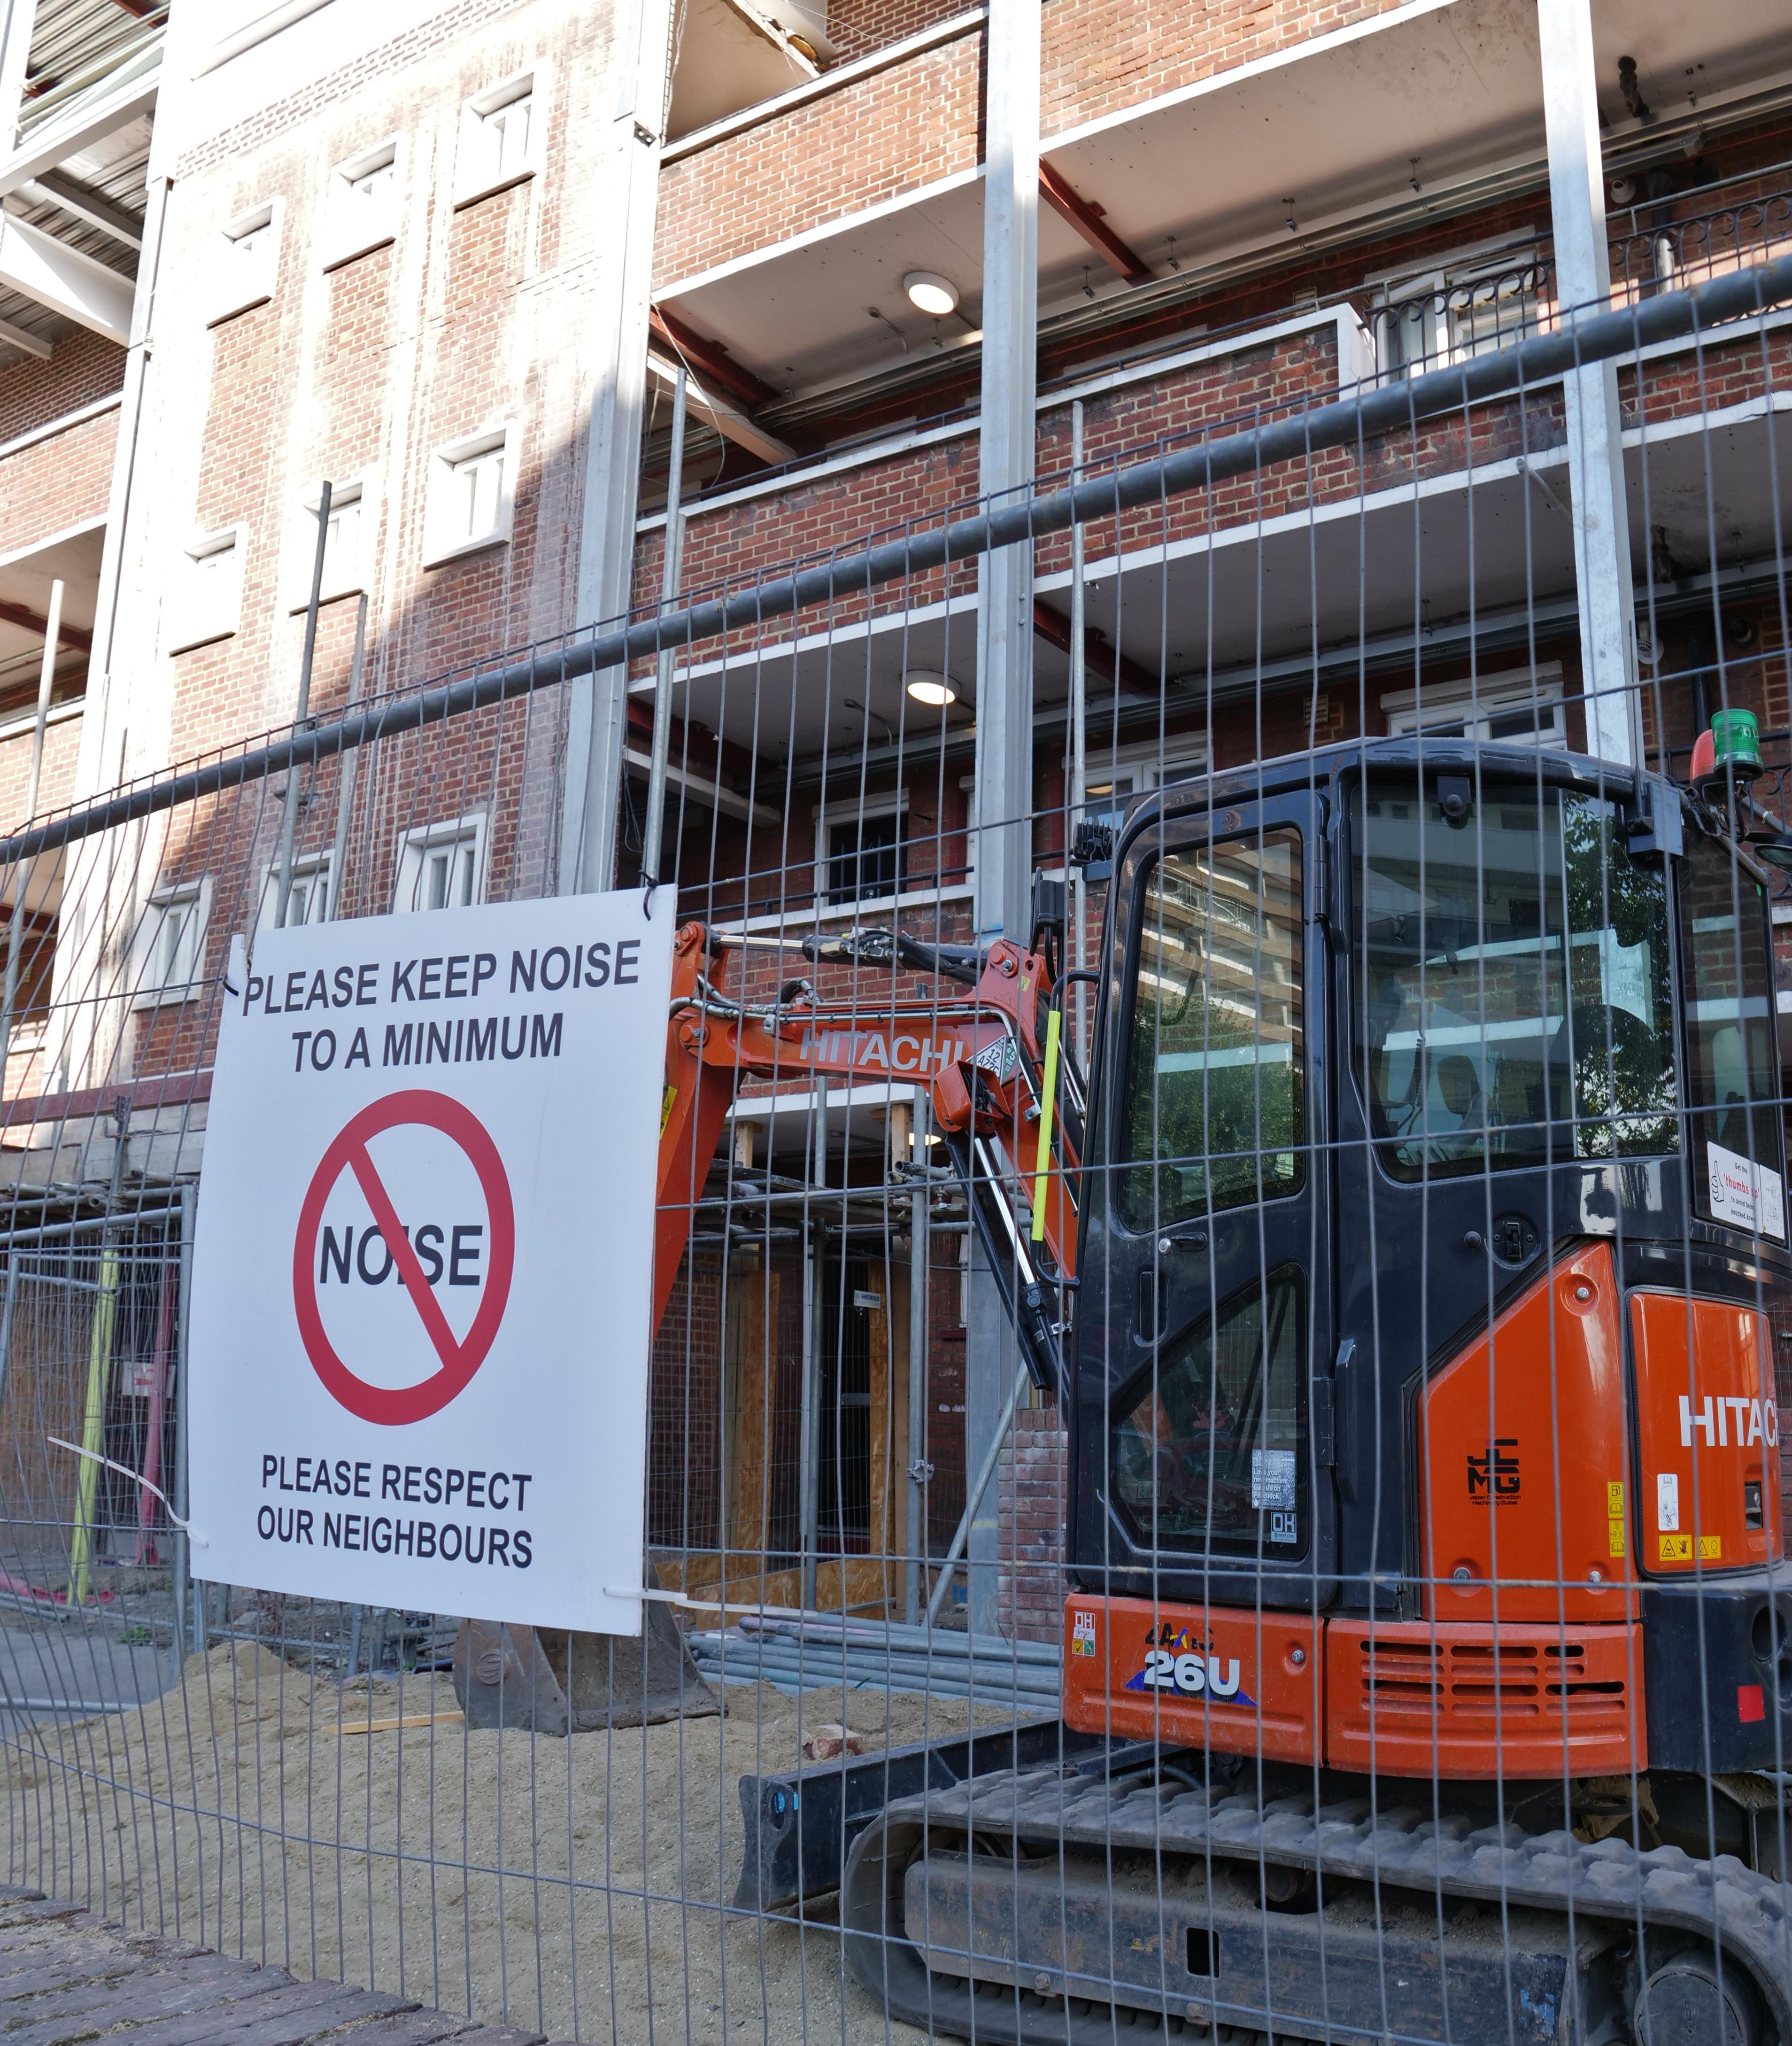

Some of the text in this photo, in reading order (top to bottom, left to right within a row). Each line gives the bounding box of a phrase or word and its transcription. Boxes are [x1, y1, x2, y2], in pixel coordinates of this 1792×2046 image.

[243, 940, 640, 1016] PLEASE KEEP NOISE
[292, 1013, 563, 1072] TO A MINIMUM
[800, 1027, 963, 1073] HITACHI
[988, 1049, 1000, 1063] 12
[1723, 1173, 1749, 1195] 'thumbs
[1731, 1208, 1746, 1219] knocked
[263, 1455, 532, 1511] PLEASE RESPECT
[258, 1505, 532, 1569] OUR NEIGHBOURS
[1143, 1650, 1240, 1697] 26U
